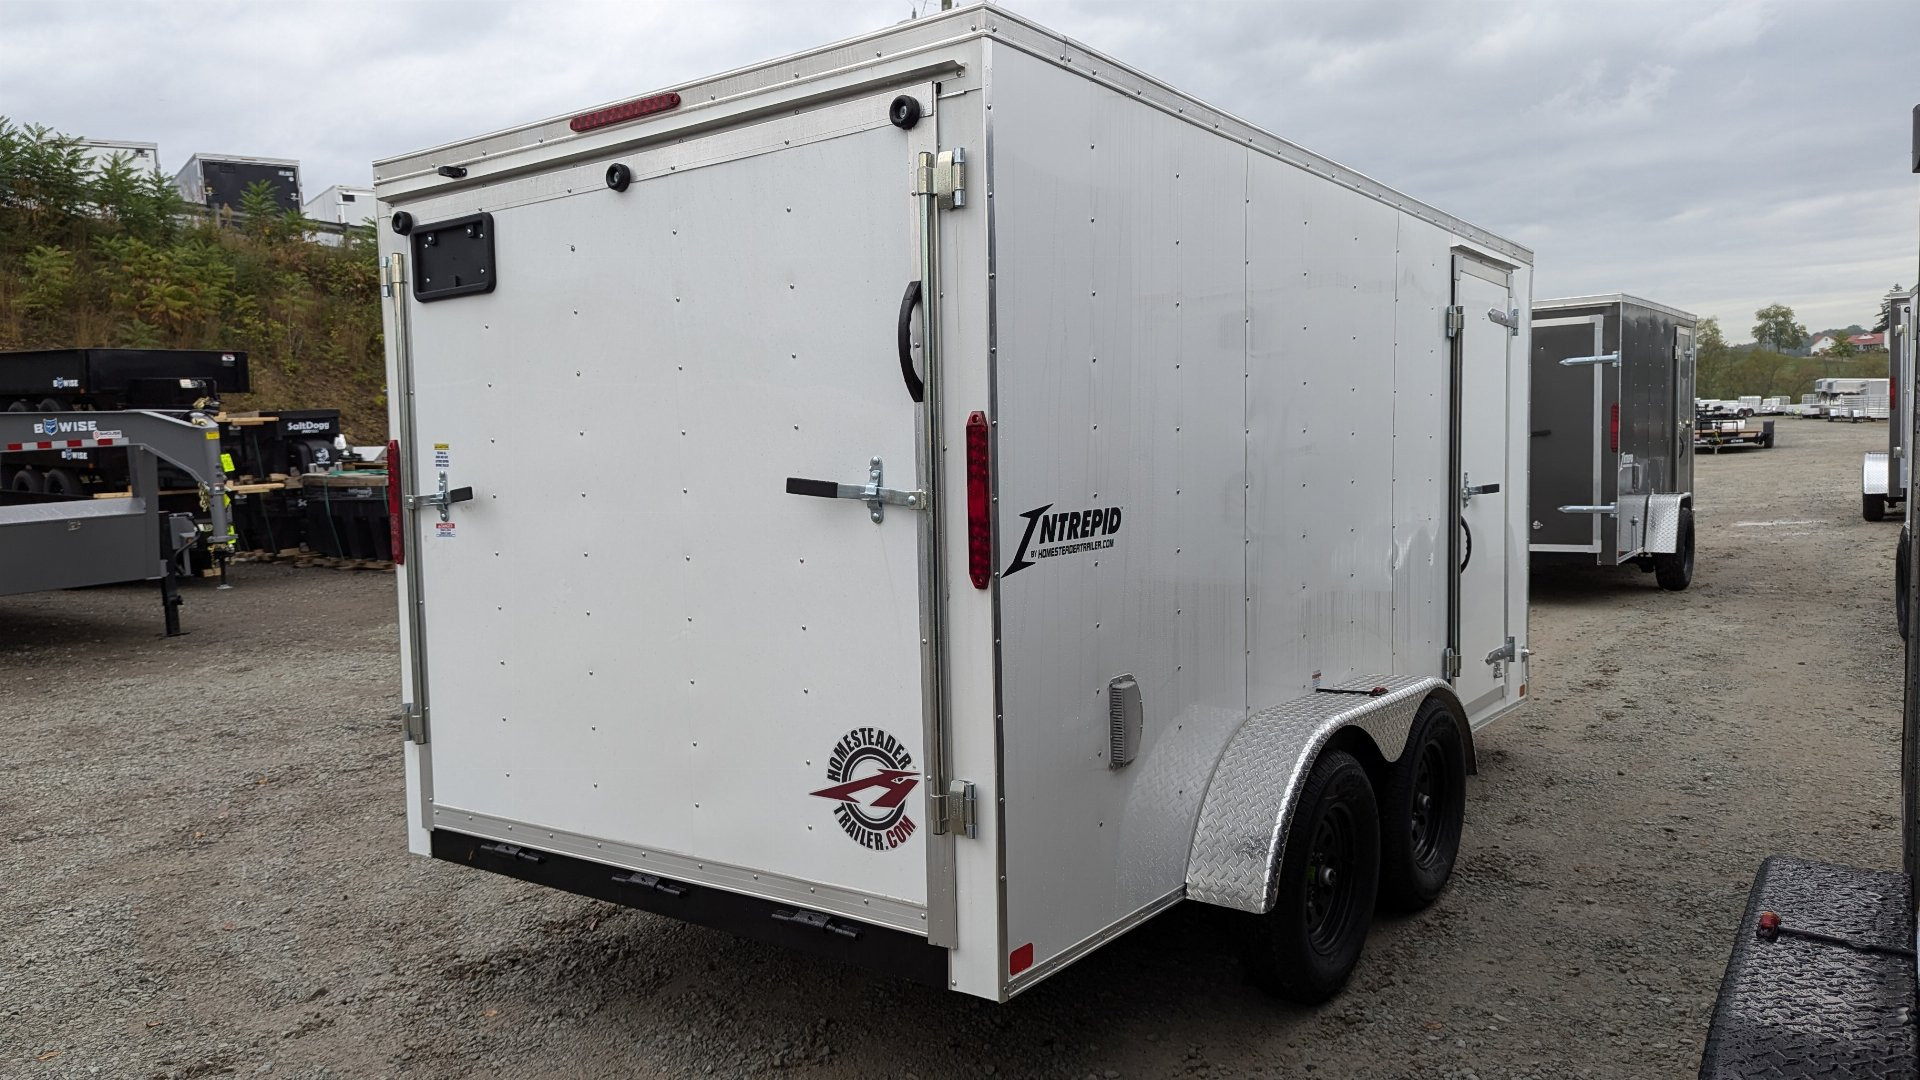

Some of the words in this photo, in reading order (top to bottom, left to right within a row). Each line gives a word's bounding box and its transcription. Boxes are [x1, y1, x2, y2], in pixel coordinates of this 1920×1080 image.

[287, 421, 330, 430] SaltDogg
[1000, 503, 1122, 578] INTREPID
[1030, 549, 1038, 558] BY
[1038, 539, 1115, 559] HOMESTEADERTRAILER.COM
[827, 727, 912, 783] HOMESTEADER
[834, 802, 917, 851] TRAILER.COM
